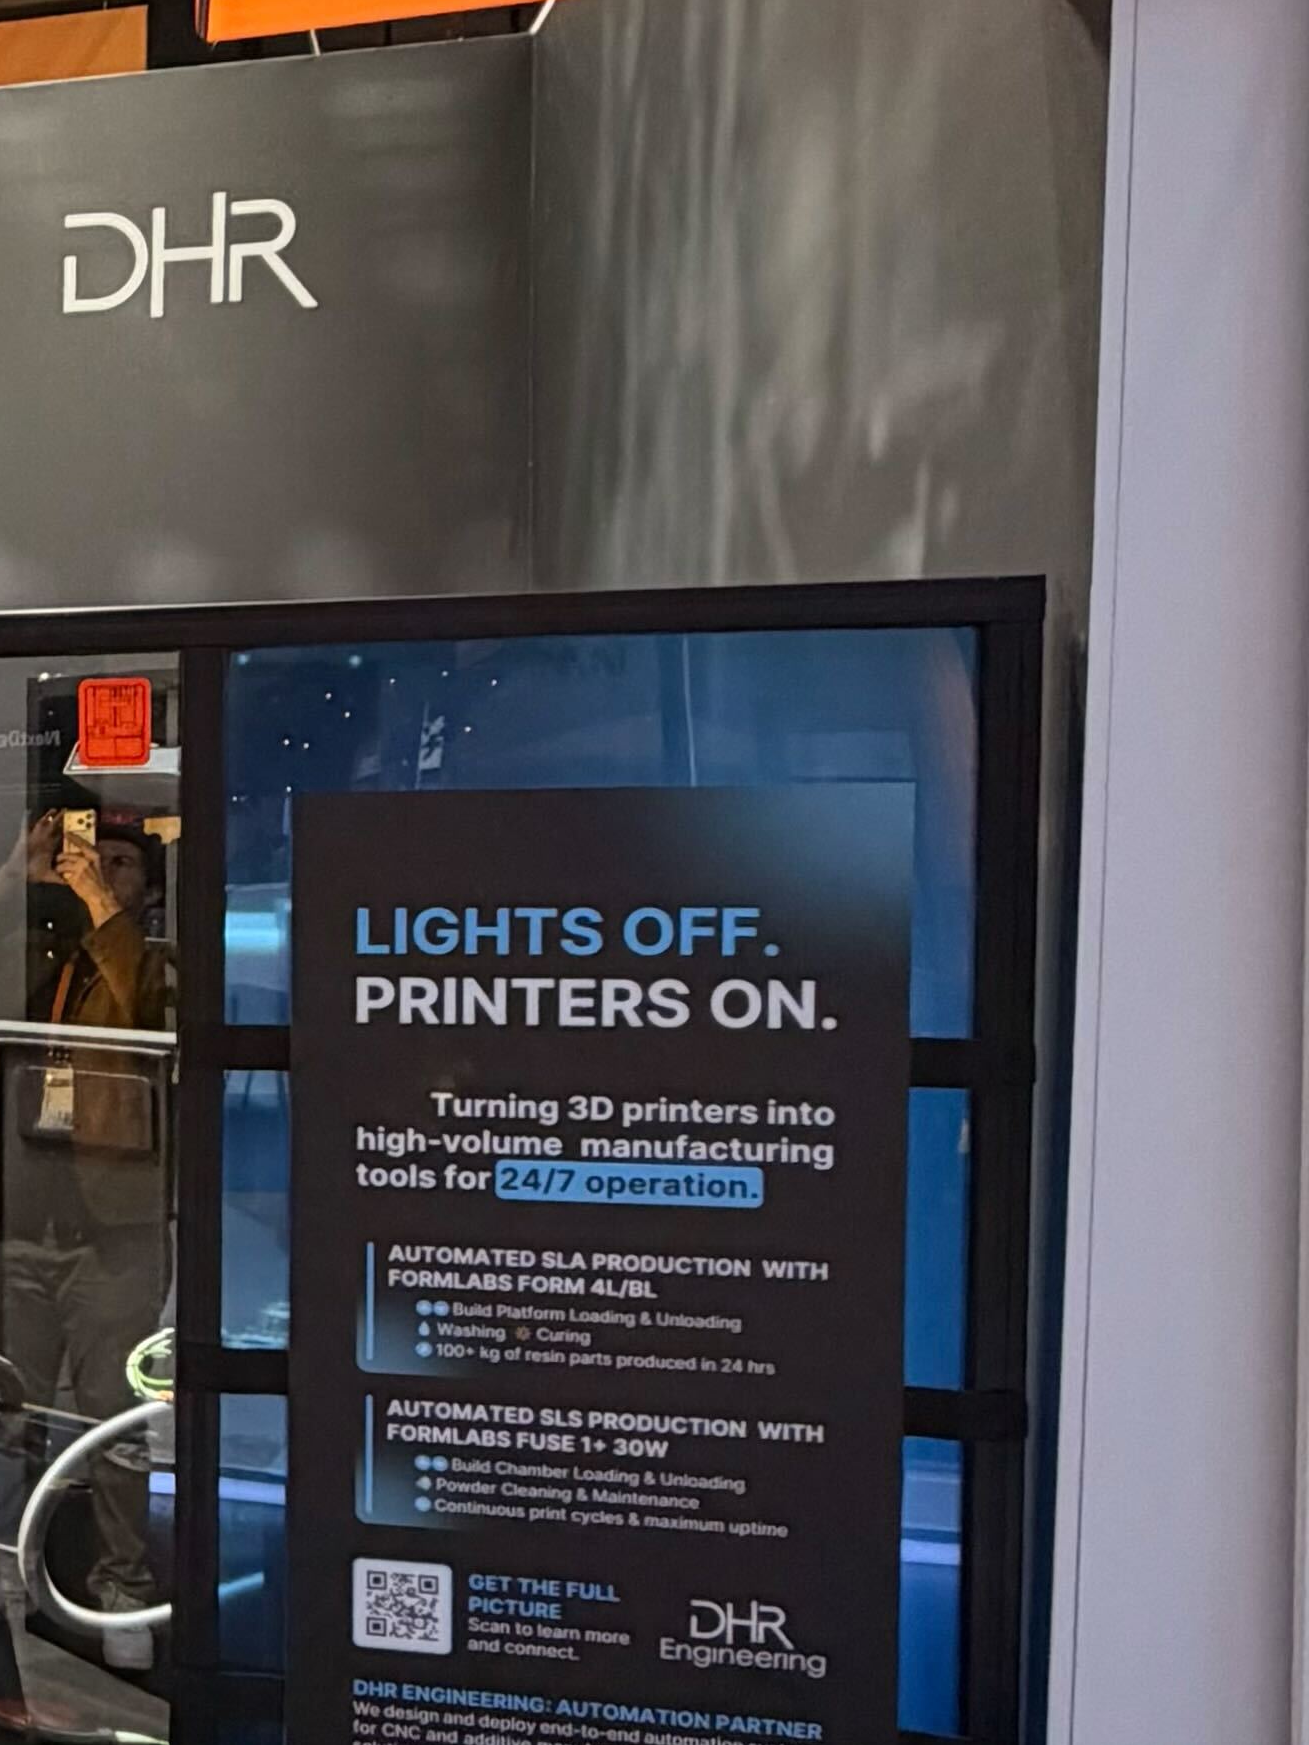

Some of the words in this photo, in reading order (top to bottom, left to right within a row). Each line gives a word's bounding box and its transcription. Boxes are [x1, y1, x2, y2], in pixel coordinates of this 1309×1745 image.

[62, 191, 318, 318] DHR
[356, 907, 604, 956] LIGHTS
[623, 906, 780, 956] OFF.
[355, 976, 691, 1029] PRINTERS
[710, 978, 838, 1031] ON.
[430, 1091, 559, 1126] Turning
[567, 1095, 614, 1122] 3D
[622, 1096, 759, 1128] printers
[767, 1099, 836, 1127] into
[356, 1126, 564, 1158] high-volume
[581, 1134, 834, 1171] manufacturing
[356, 1162, 437, 1189] tools
[444, 1164, 492, 1191] for
[500, 1166, 576, 1194] 24/7
[584, 1172, 760, 1200] operation.
[388, 1244, 536, 1268] AUTOMATED
[541, 1251, 587, 1270] SLA
[592, 1253, 752, 1278] PRODUCTION
[762, 1259, 829, 1281] WITH
[388, 1269, 512, 1292] FORMLABS
[517, 1275, 585, 1295] FORM
[590, 1278, 658, 1300] 4L/BL
[436, 1321, 506, 1343] Washing
[452, 1302, 492, 1318] Build
[496, 1305, 565, 1322] Platform
[569, 1308, 636, 1328] Loading
[639, 1310, 652, 1327] &
[656, 1311, 743, 1334] Unloading
[536, 1326, 592, 1347] Curing
[436, 1342, 475, 1359] 100+
[480, 1345, 501, 1364] kg
[504, 1346, 521, 1362] of
[525, 1348, 566, 1364] resin
[569, 1352, 612, 1367] parts
[616, 1354, 697, 1372] produced
[701, 1357, 717, 1372] in
[721, 1358, 743, 1373] 24
[747, 1360, 776, 1376] hrs
[387, 1398, 535, 1425] AUTOMATED
[540, 1408, 583, 1428] SLS
[588, 1410, 747, 1439] PRODUCTION
[757, 1420, 825, 1444] WITH
[387, 1422, 511, 1448] FORMLABS
[516, 1431, 576, 1453] FUSE
[581, 1435, 607, 1454] 1+
[613, 1438, 669, 1459] 30W
[436, 1476, 496, 1495] Powder
[501, 1480, 572, 1504] Cleaning
[576, 1486, 588, 1502] &
[592, 1488, 700, 1510] Maintenance
[451, 1457, 491, 1474] Build
[495, 1460, 569, 1480] Chamber
[573, 1466, 640, 1487] Loading
[643, 1470, 656, 1486] &
[660, 1471, 746, 1496] Unloading
[434, 1497, 526, 1519] Continuous
[530, 1504, 567, 1522] print
[571, 1509, 624, 1526] cycles
[628, 1511, 640, 1527] &
[644, 1513, 725, 1533] maximum
[729, 1520, 789, 1538] uptime
[468, 1573, 513, 1593] GET
[517, 1577, 561, 1597] THE
[566, 1580, 621, 1603] FULL
[468, 1595, 562, 1620] PICTURE
[689, 1599, 795, 1651] DHR
[467, 1636, 501, 1654] and
[504, 1638, 581, 1661] connect.
[468, 1616, 511, 1635] Scan
[515, 1621, 534, 1637] to
[537, 1622, 582, 1641] learn
[585, 1629, 631, 1646] more
[659, 1637, 828, 1680] Engineering
[352, 1677, 398, 1699] DHR
[402, 1682, 552, 1714] ENGINEERING:
[555, 1698, 711, 1729] AUTOMATION
[715, 1713, 823, 1741] PARTNER
[352, 1700, 381, 1718] We
[383, 1702, 440, 1726] design
[443, 1710, 476, 1728] and
[478, 1714, 536, 1735] deploy
[539, 1719, 641, 1745] end-to-end
[352, 1719, 377, 1736] for
[381, 1722, 422, 1741] CNC
[426, 1728, 458, 1745] and
